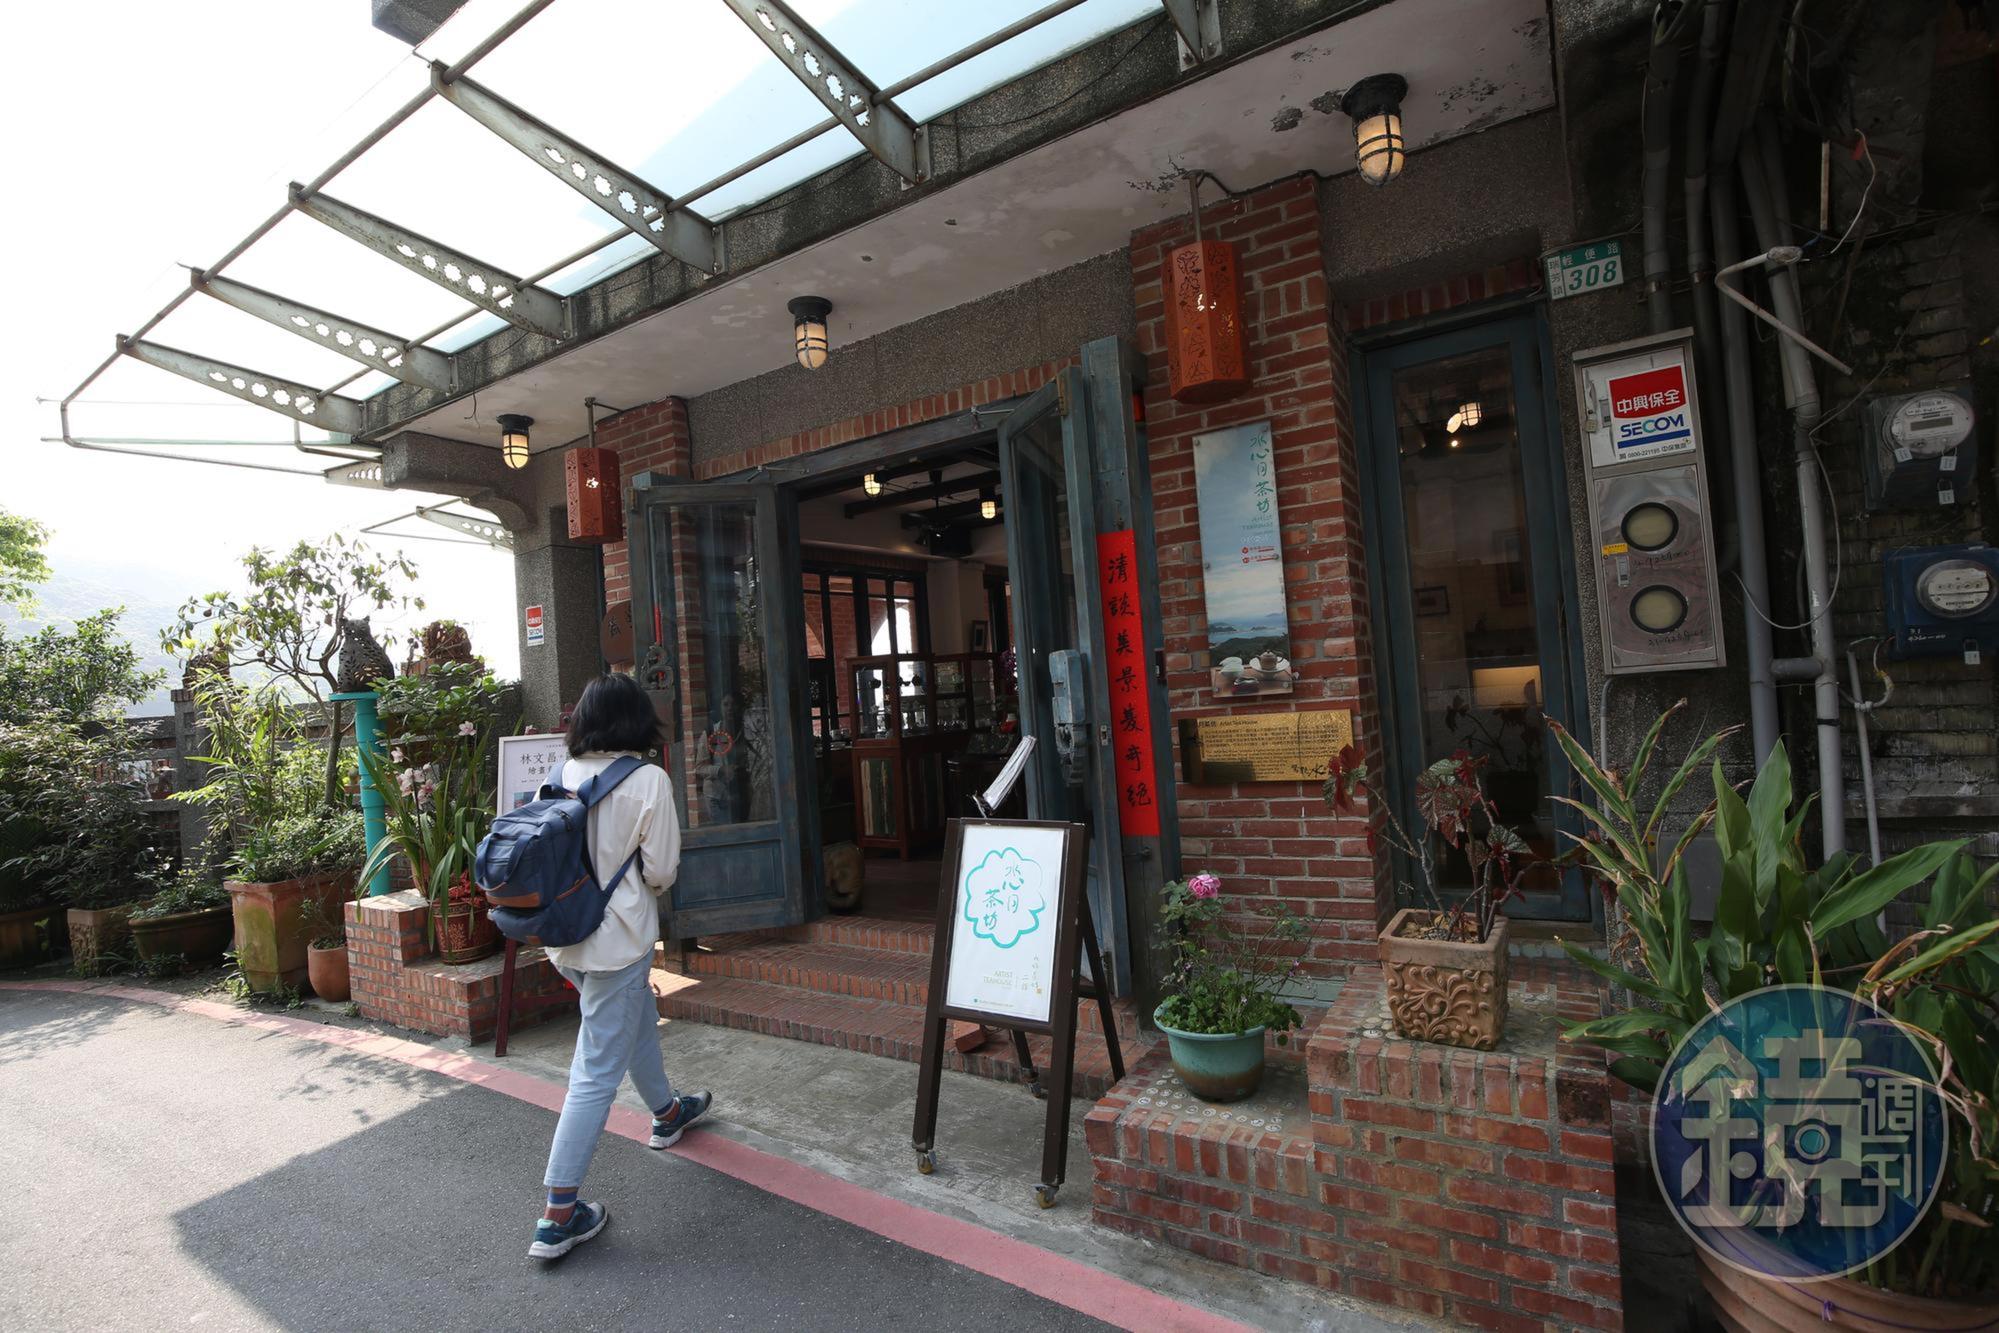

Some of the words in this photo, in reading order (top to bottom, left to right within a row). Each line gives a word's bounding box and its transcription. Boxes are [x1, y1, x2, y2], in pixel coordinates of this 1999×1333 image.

[1568, 260, 1617, 291] 308
[1616, 389, 1680, 413] 中興保全
[1620, 413, 1684, 438] SECOM
[1249, 434, 1274, 513] 水心月茶坊
[528, 765, 552, 775] 繪畫
